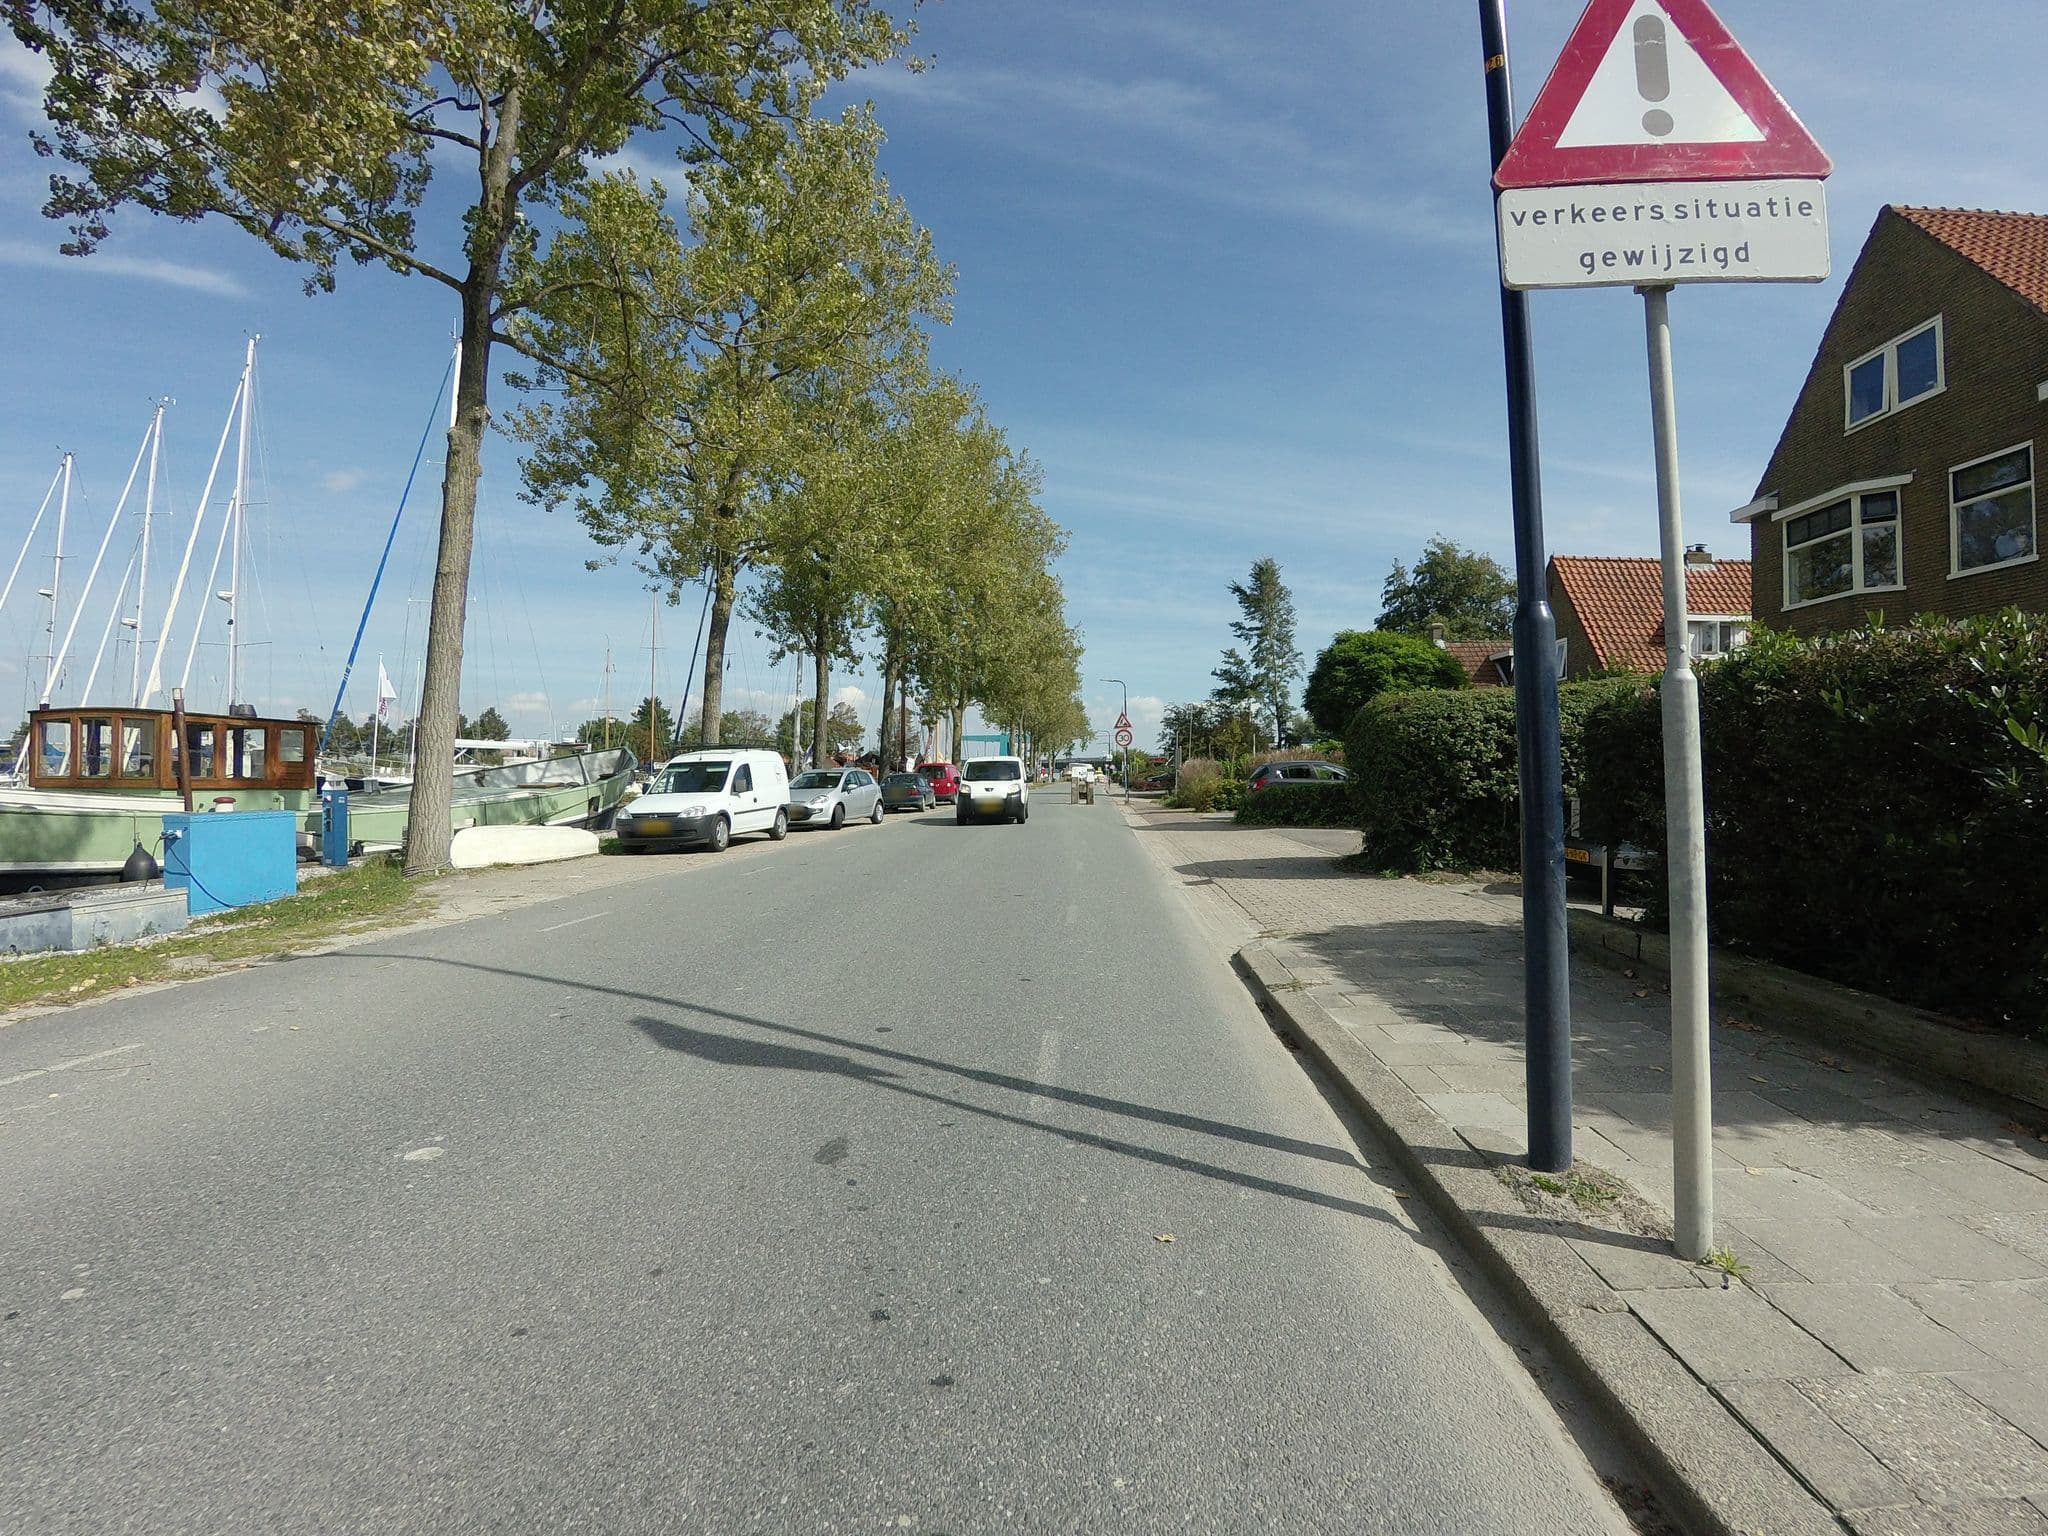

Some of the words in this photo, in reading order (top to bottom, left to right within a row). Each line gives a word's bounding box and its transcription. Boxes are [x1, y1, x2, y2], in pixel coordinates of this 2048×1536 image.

[1510, 196, 1814, 226] verkeerssituatie
[1580, 241, 1751, 275] gewijzigd
[1118, 734, 1130, 742] 30
